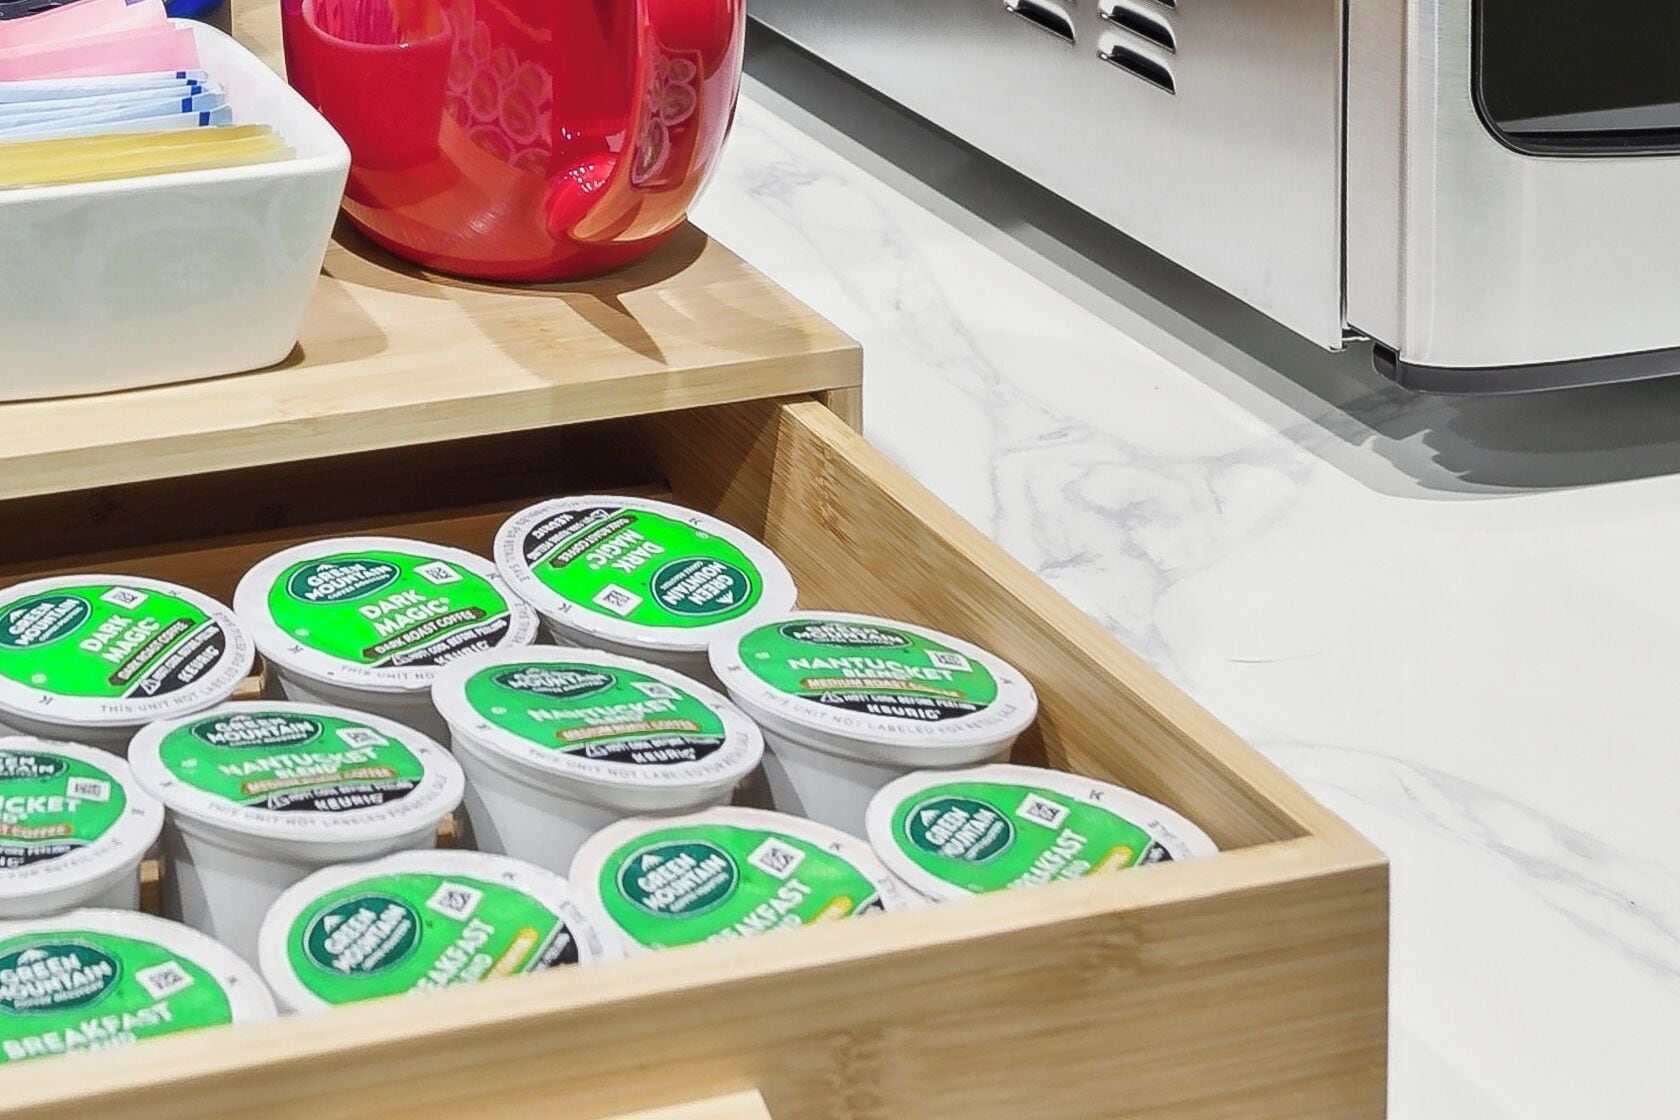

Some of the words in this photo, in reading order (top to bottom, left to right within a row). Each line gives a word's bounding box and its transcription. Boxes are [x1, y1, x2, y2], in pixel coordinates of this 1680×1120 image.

[611, 540, 665, 573] DARK
[305, 566, 392, 600] MOUNTAIN
[307, 564, 366, 586] GREEN
[662, 562, 727, 605] MOUNTAIN
[688, 574, 733, 605] GREEN
[9, 603, 55, 635] GREEN
[359, 589, 426, 620] DARK
[15, 599, 80, 645] MOUNTAIN
[80, 615, 133, 652] DARK
[375, 637, 406, 654] DARK
[404, 623, 438, 642] ROAST
[438, 610, 476, 629] COFFEE
[178, 645, 219, 682] KEURIG
[787, 657, 954, 682] NANTUCKET
[207, 721, 314, 744] MOUNTAIN
[3, 1001, 173, 1060] BREAKFAST
